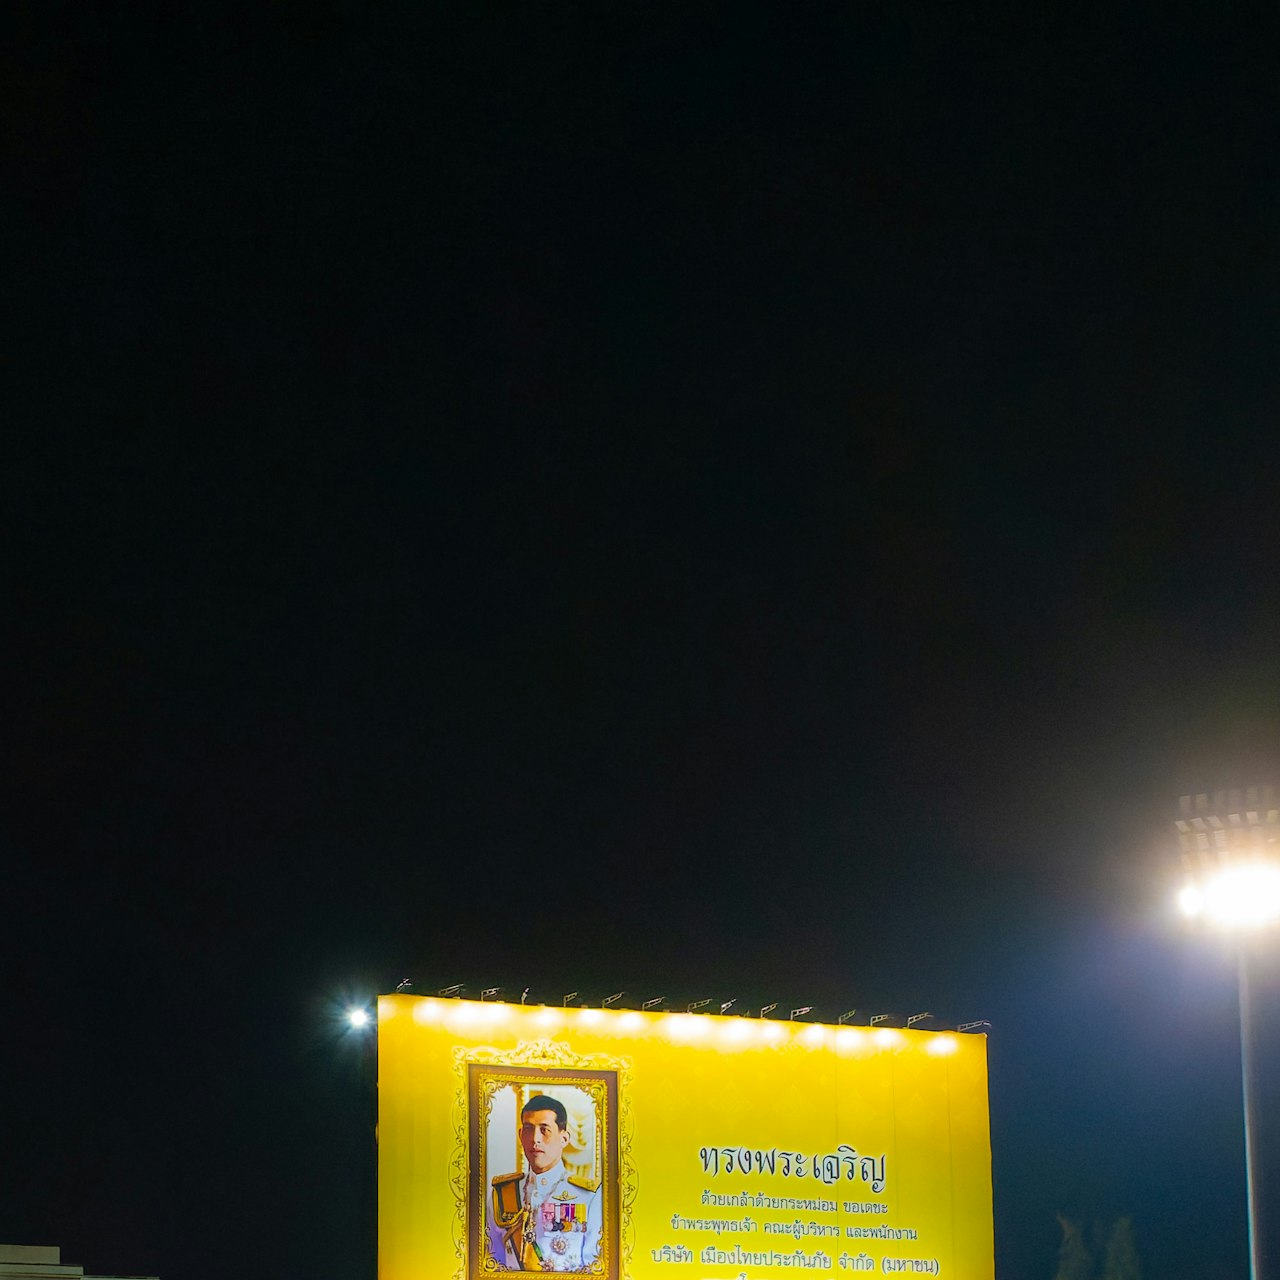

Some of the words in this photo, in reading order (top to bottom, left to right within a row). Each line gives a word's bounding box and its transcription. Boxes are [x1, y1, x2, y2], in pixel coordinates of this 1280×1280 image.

[700, 1145, 886, 1193] ทรงพระเจริญ
[701, 1189, 838, 1212] ด้วยเกล้าด้วยกระหม่อม
[844, 1202, 888, 1214] ขอเดชะ
[671, 1214, 758, 1235] ข้าพระพุทธเจ้า
[764, 1219, 840, 1240] คณะผู้บริหาร
[846, 1224, 918, 1240] และพนักงาน
[651, 1245, 693, 1263] บริษัท
[701, 1245, 832, 1270] เมืองไทยประกันภัย
[839, 1253, 875, 1271] จำกัด
[881, 1256, 940, 1275] (มหาชน)
